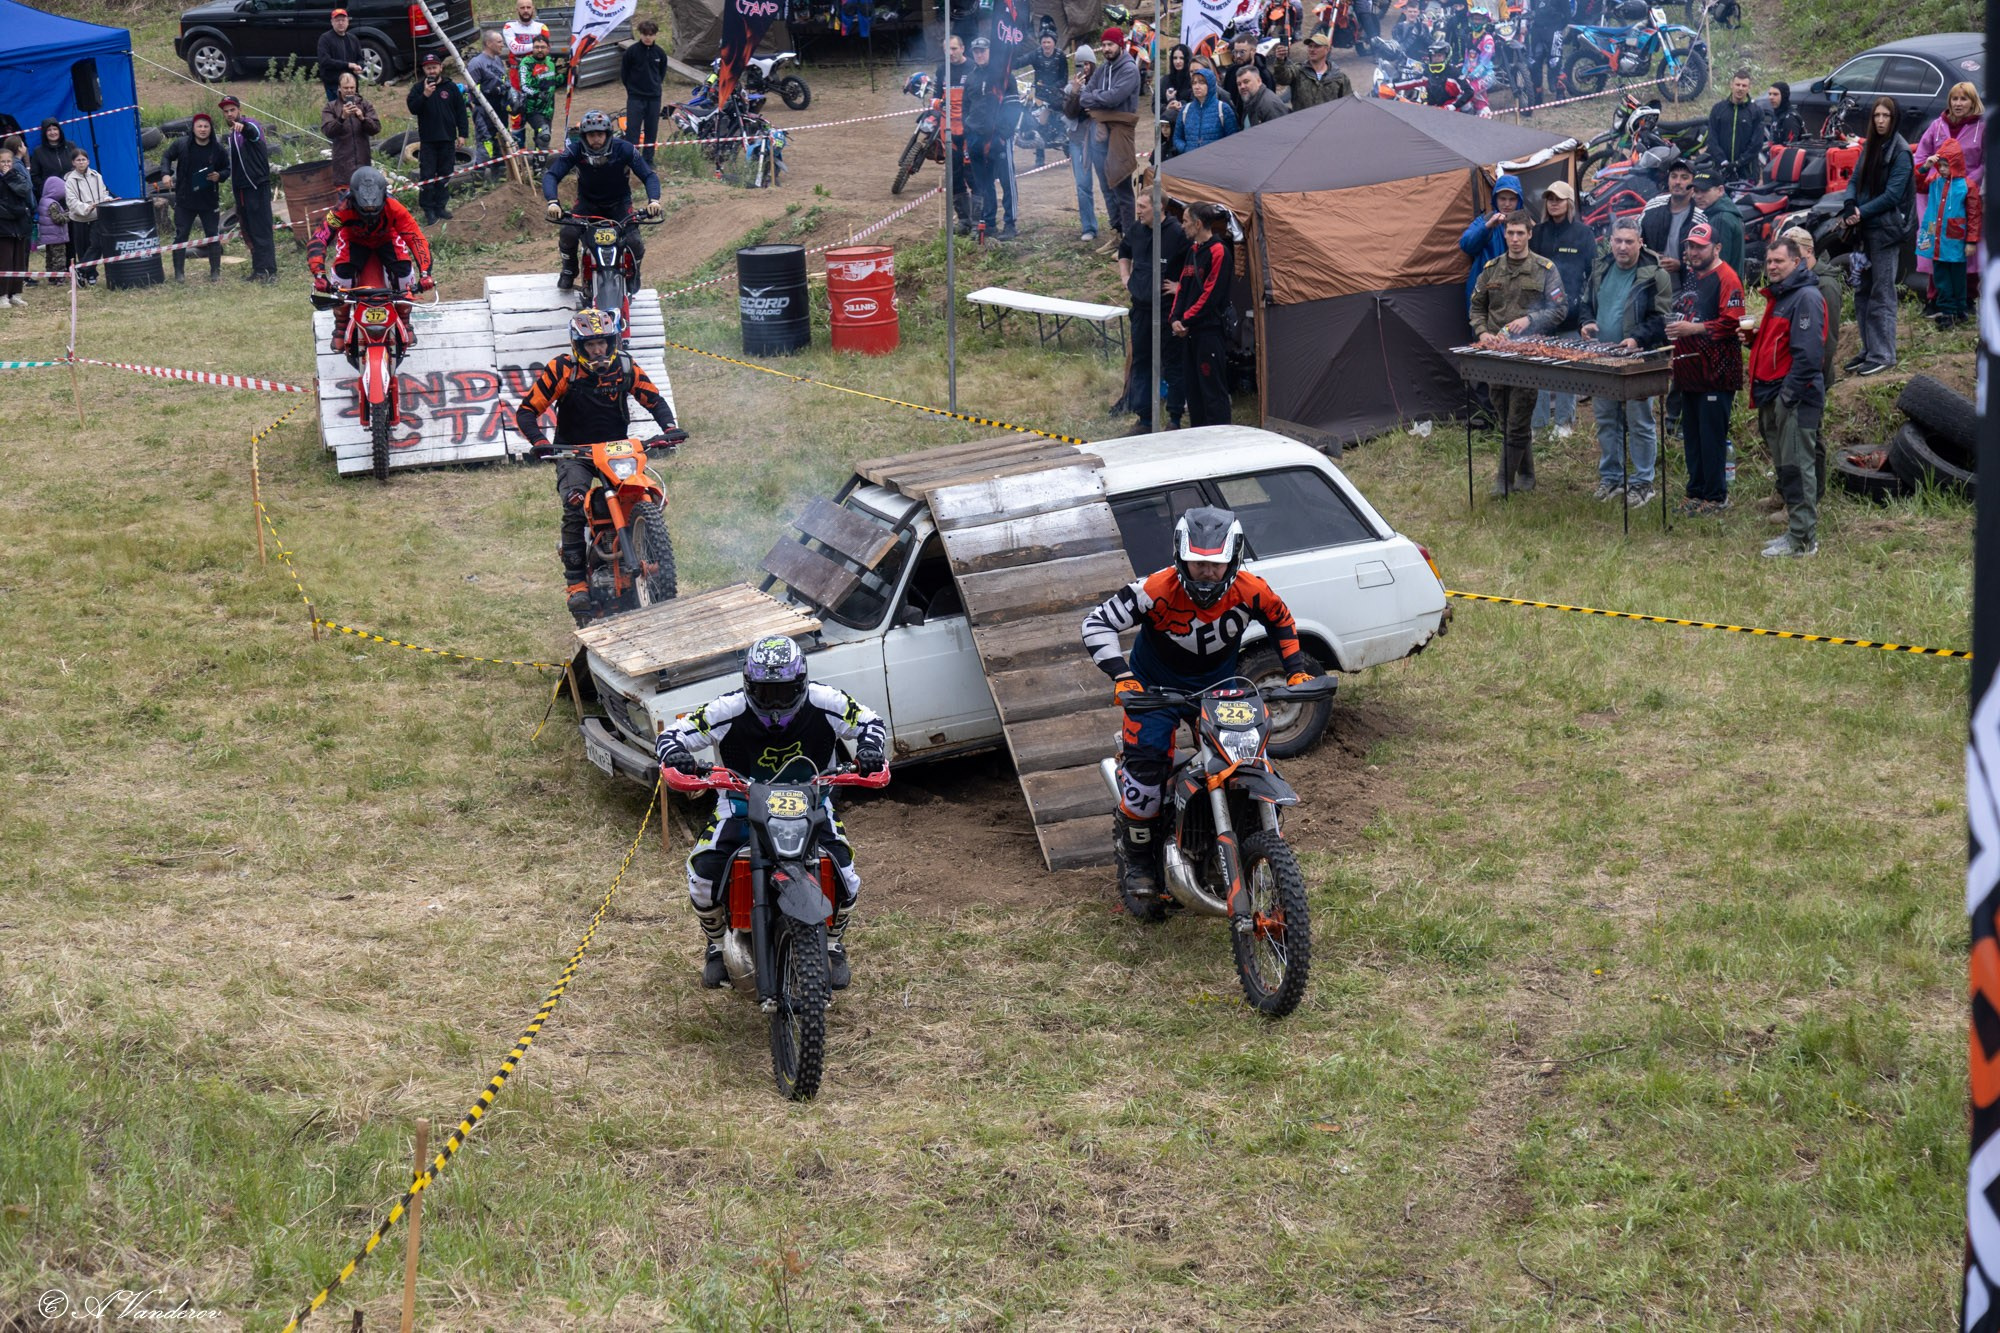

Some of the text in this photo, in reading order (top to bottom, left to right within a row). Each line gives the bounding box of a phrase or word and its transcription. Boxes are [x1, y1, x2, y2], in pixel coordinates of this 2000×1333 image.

[115, 236, 160, 251] RECOR
[741, 296, 790, 309] ECORD
[843, 302, 877, 312] SINTEC
[371, 312, 381, 320] 17
[1195, 591, 1269, 656] FOX
[1226, 708, 1245, 720] 24
[778, 798, 797, 811] 23
[1218, 844, 1230, 886] CHAMP
